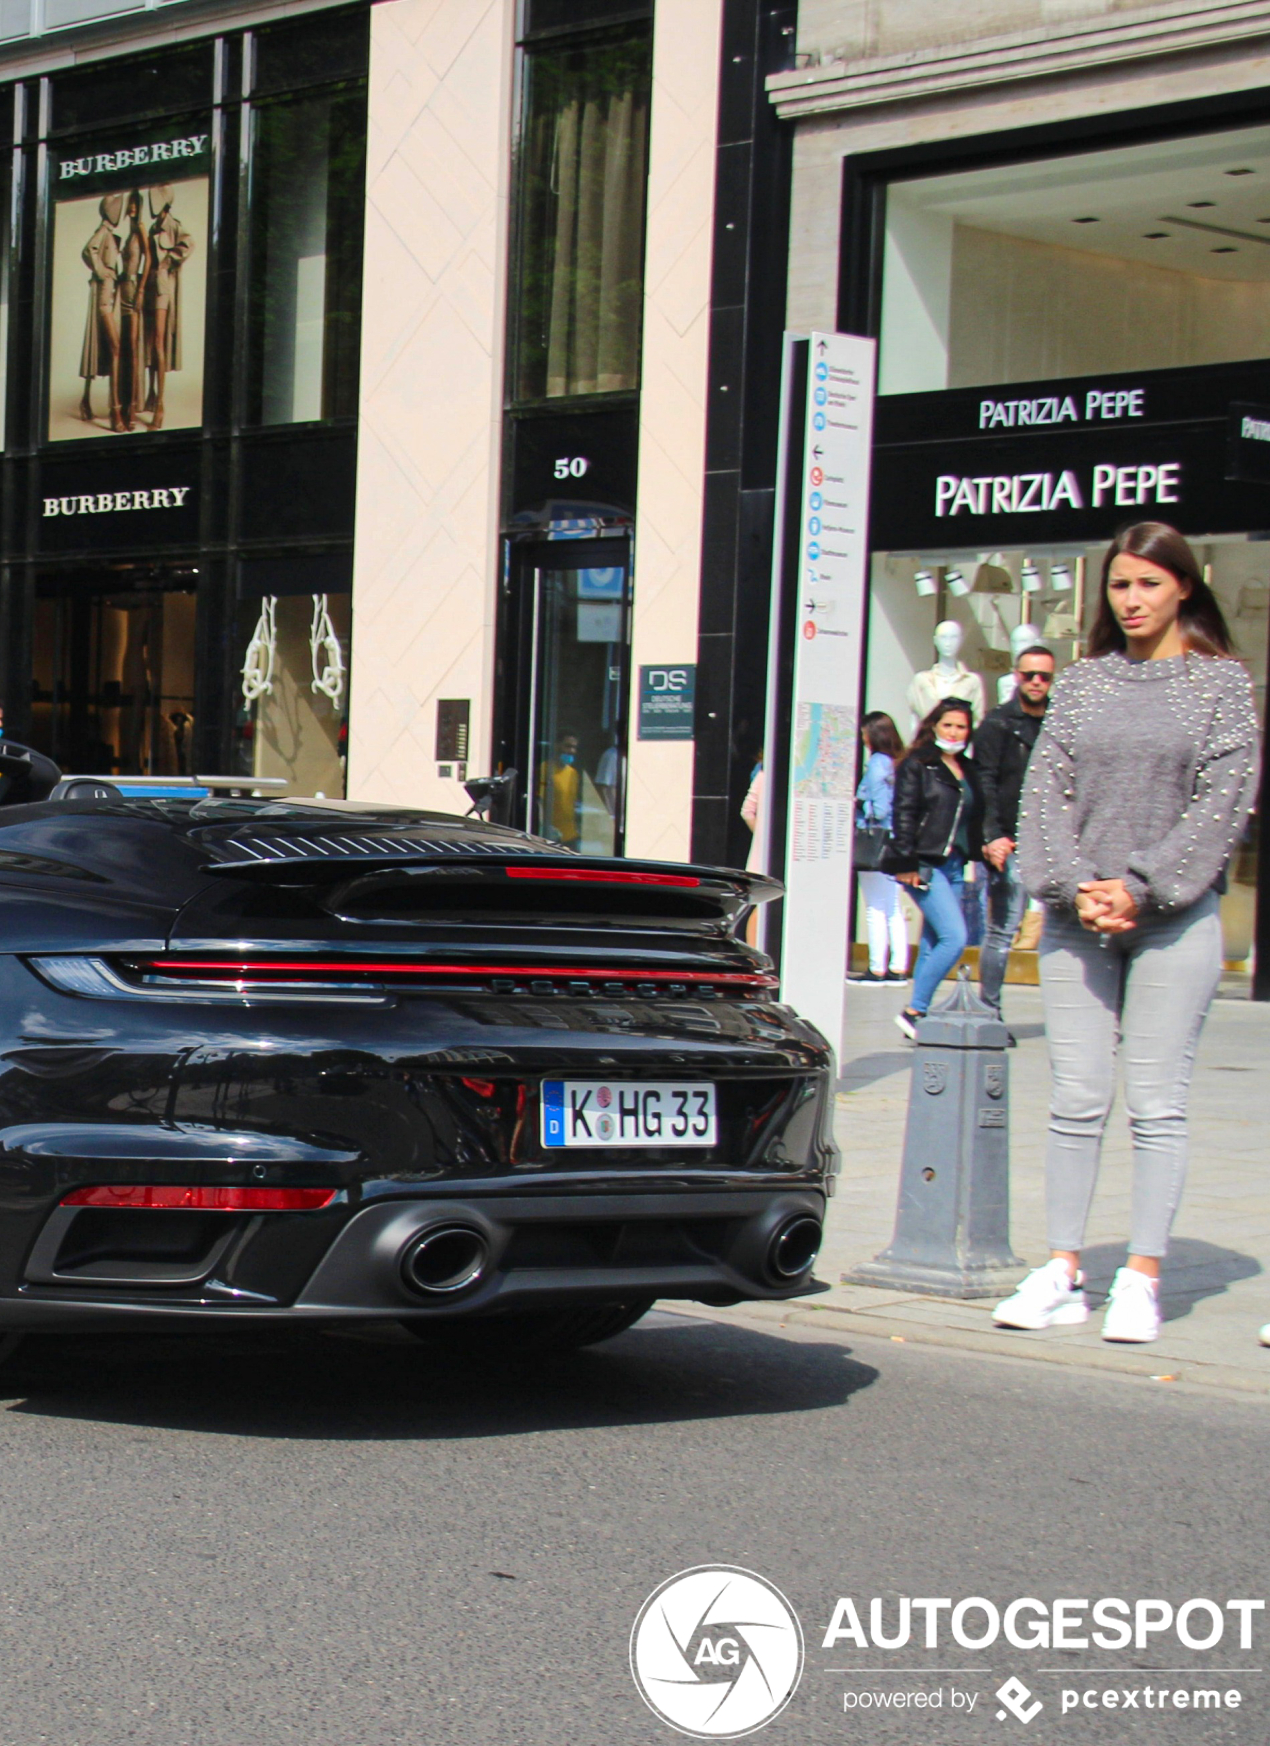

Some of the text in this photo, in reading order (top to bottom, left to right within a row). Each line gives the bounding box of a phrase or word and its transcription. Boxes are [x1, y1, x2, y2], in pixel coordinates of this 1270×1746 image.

[59, 134, 208, 180] BURBERRY
[979, 389, 1145, 429] PATRIZIA PEPE
[554, 457, 589, 479] 50
[43, 487, 190, 517] BURBERRY
[935, 463, 1182, 518] PATRIZIA PEPE
[649, 670, 687, 691] DS
[492, 979, 716, 999] PORSCHE
[550, 1089, 709, 1138] D K HG 33
